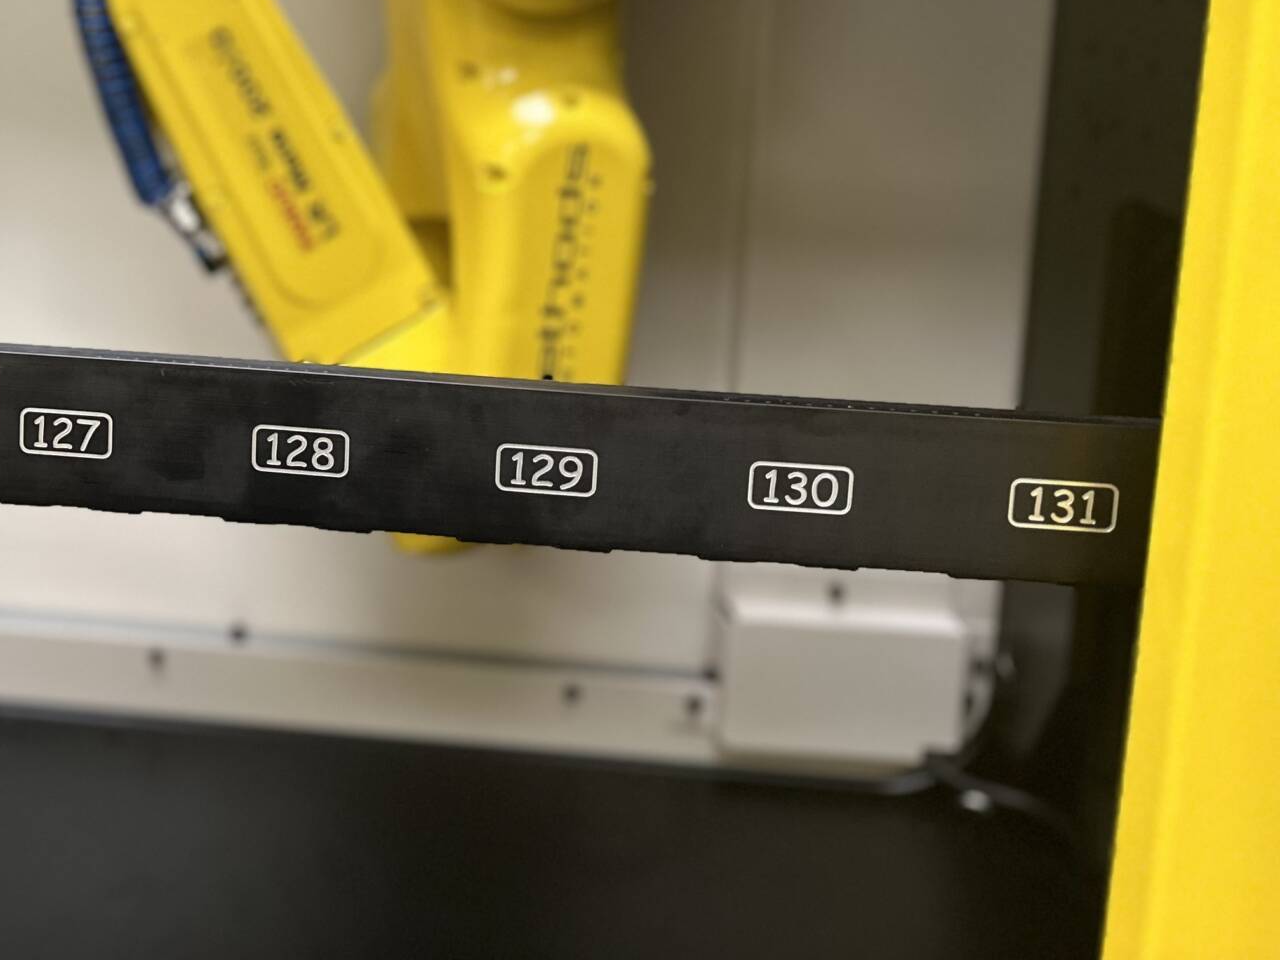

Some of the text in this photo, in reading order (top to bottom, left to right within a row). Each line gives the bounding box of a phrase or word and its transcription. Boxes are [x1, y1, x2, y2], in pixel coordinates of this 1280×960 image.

[33, 415, 101, 452] 127
[266, 432, 335, 471] 128
[510, 451, 584, 491] 129
[763, 469, 839, 508] 130
[1027, 486, 1096, 525] 131
